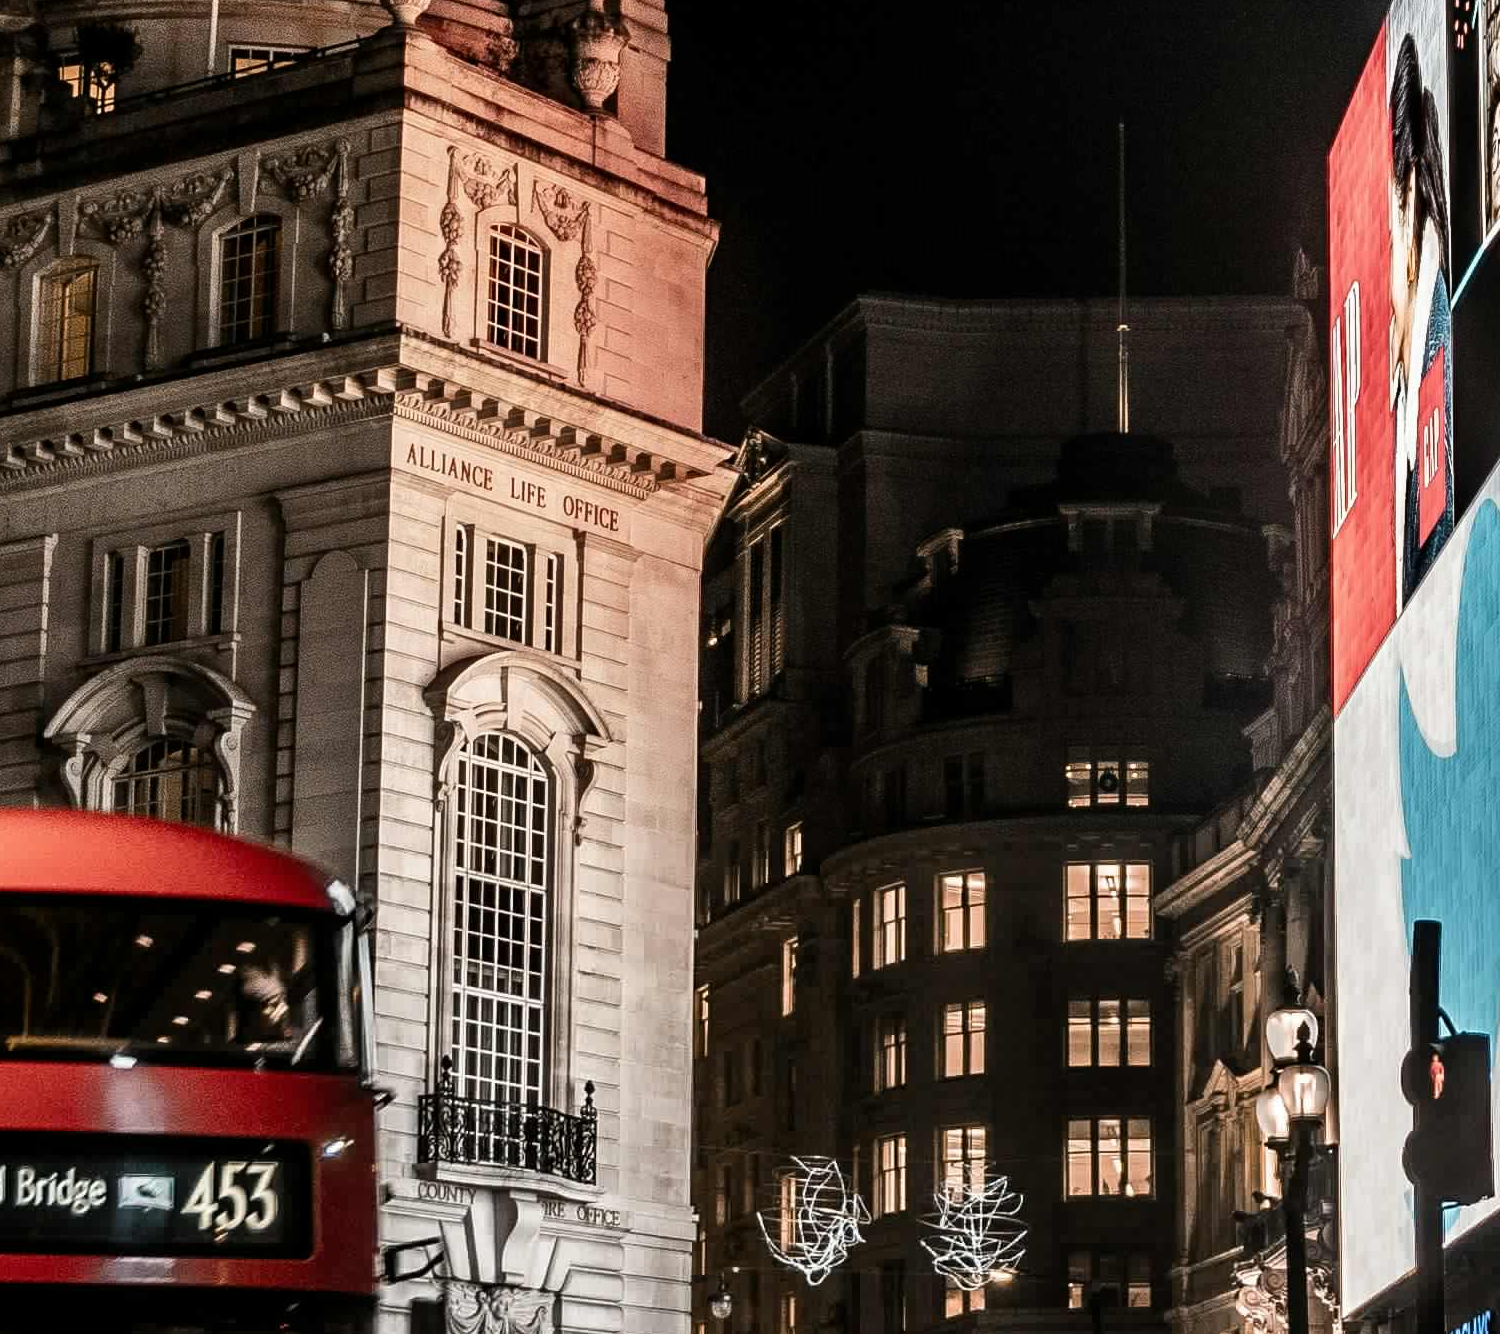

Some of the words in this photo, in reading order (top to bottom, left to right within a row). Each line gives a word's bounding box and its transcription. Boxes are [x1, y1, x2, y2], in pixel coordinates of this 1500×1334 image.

[406, 442, 493, 491] ALLIANCE
[510, 477, 547, 508] LIFE
[563, 495, 620, 532] OFFICE
[14, 1163, 109, 1216] Bridge
[181, 1160, 281, 1232] 453
[418, 1182, 477, 1205] COUNTY
[576, 1205, 621, 1227] OFFICE
